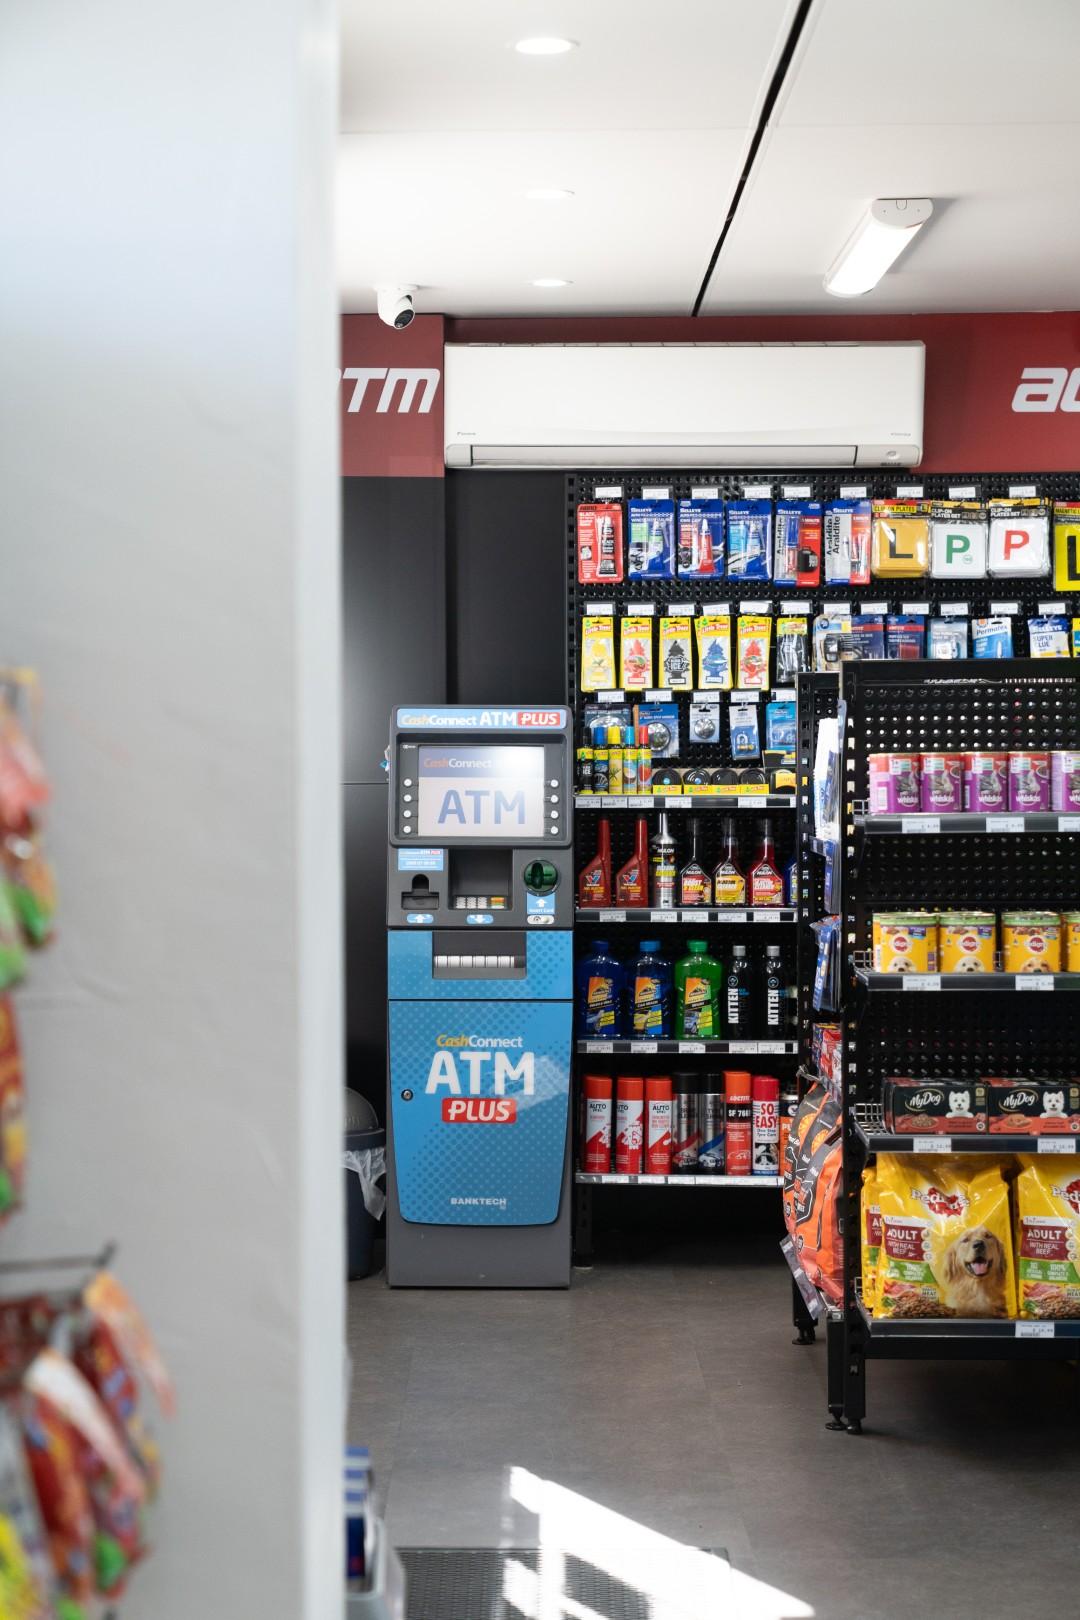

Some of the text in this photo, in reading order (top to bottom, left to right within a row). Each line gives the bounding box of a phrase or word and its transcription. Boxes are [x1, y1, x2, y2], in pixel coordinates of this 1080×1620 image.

[833, 516, 841, 554] Araldite
[889, 529, 913, 559] L
[946, 534, 971, 564] P
[1004, 530, 1030, 560] P
[977, 625, 1007, 634] Permatex
[480, 712, 516, 726] ATM
[521, 713, 558, 725] PLUS
[424, 761, 491, 772] CashConnect
[438, 790, 525, 824] ATM
[728, 988, 738, 1023] KITTEN
[768, 990, 778, 1025] KITTEN
[436, 1035, 523, 1048] CashConnect
[425, 1051, 535, 1096] ATM
[761, 1103, 774, 1115] SO
[909, 1092, 942, 1109] MyDog
[1003, 1092, 1036, 1109] MyDog
[448, 1101, 511, 1121] PLUS
[756, 1116, 777, 1128] EASY
[886, 1229, 918, 1240] ADULT
[1027, 1229, 1062, 1240] ADULT
